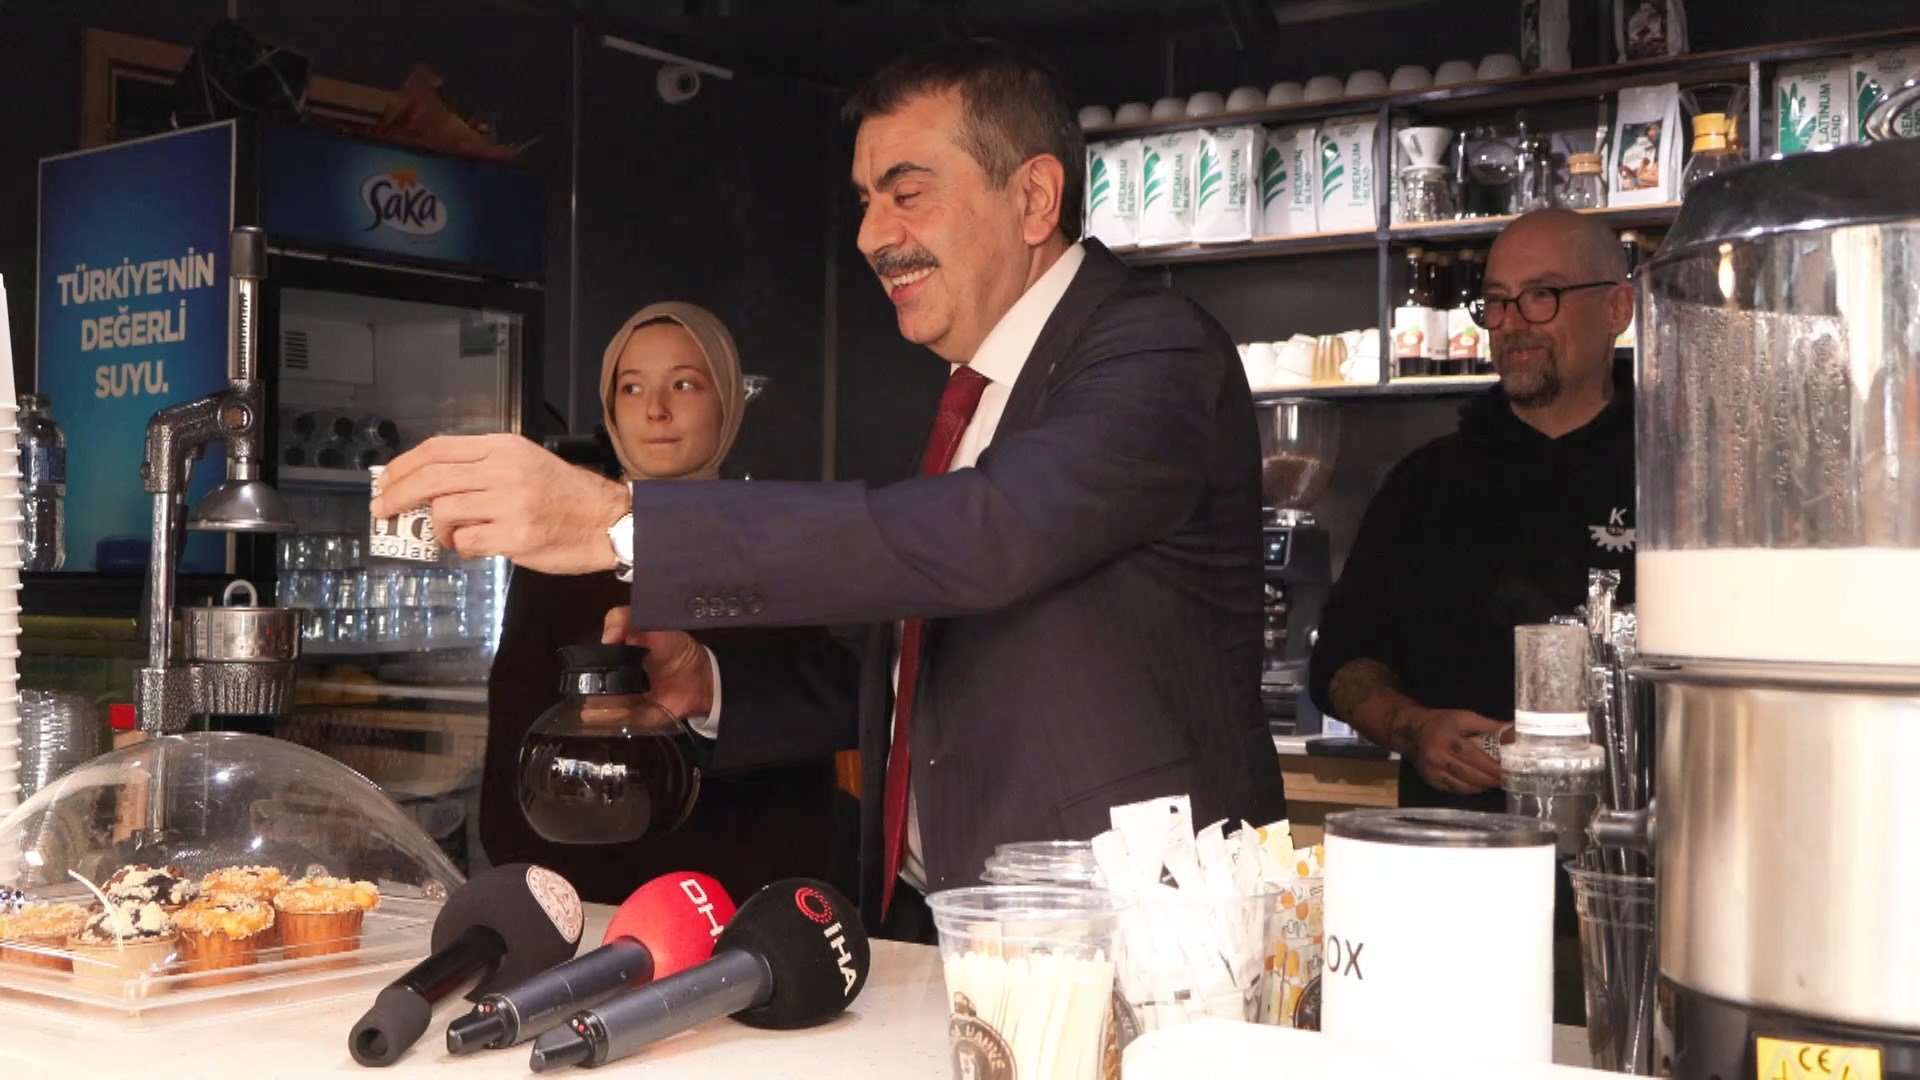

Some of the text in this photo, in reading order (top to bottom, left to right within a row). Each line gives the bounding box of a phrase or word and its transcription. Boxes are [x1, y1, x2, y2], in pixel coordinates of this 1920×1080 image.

[1118, 159, 1128, 212] PREMIUM
[1173, 153, 1184, 208] PREMIUM
[1229, 149, 1240, 205] PREMIUM
[1294, 149, 1303, 204] PREMIUM
[1352, 142, 1361, 199] PREMIUM
[363, 180, 437, 232] Saka
[57, 247, 215, 306] TÜRKİYE'NİN
[81, 299, 187, 352] DEĞERLİ
[95, 360, 169, 399] SUYU.
[1609, 507, 1627, 526] K
[680, 879, 724, 944] DH
[1799, 1046, 1832, 1074] CE
